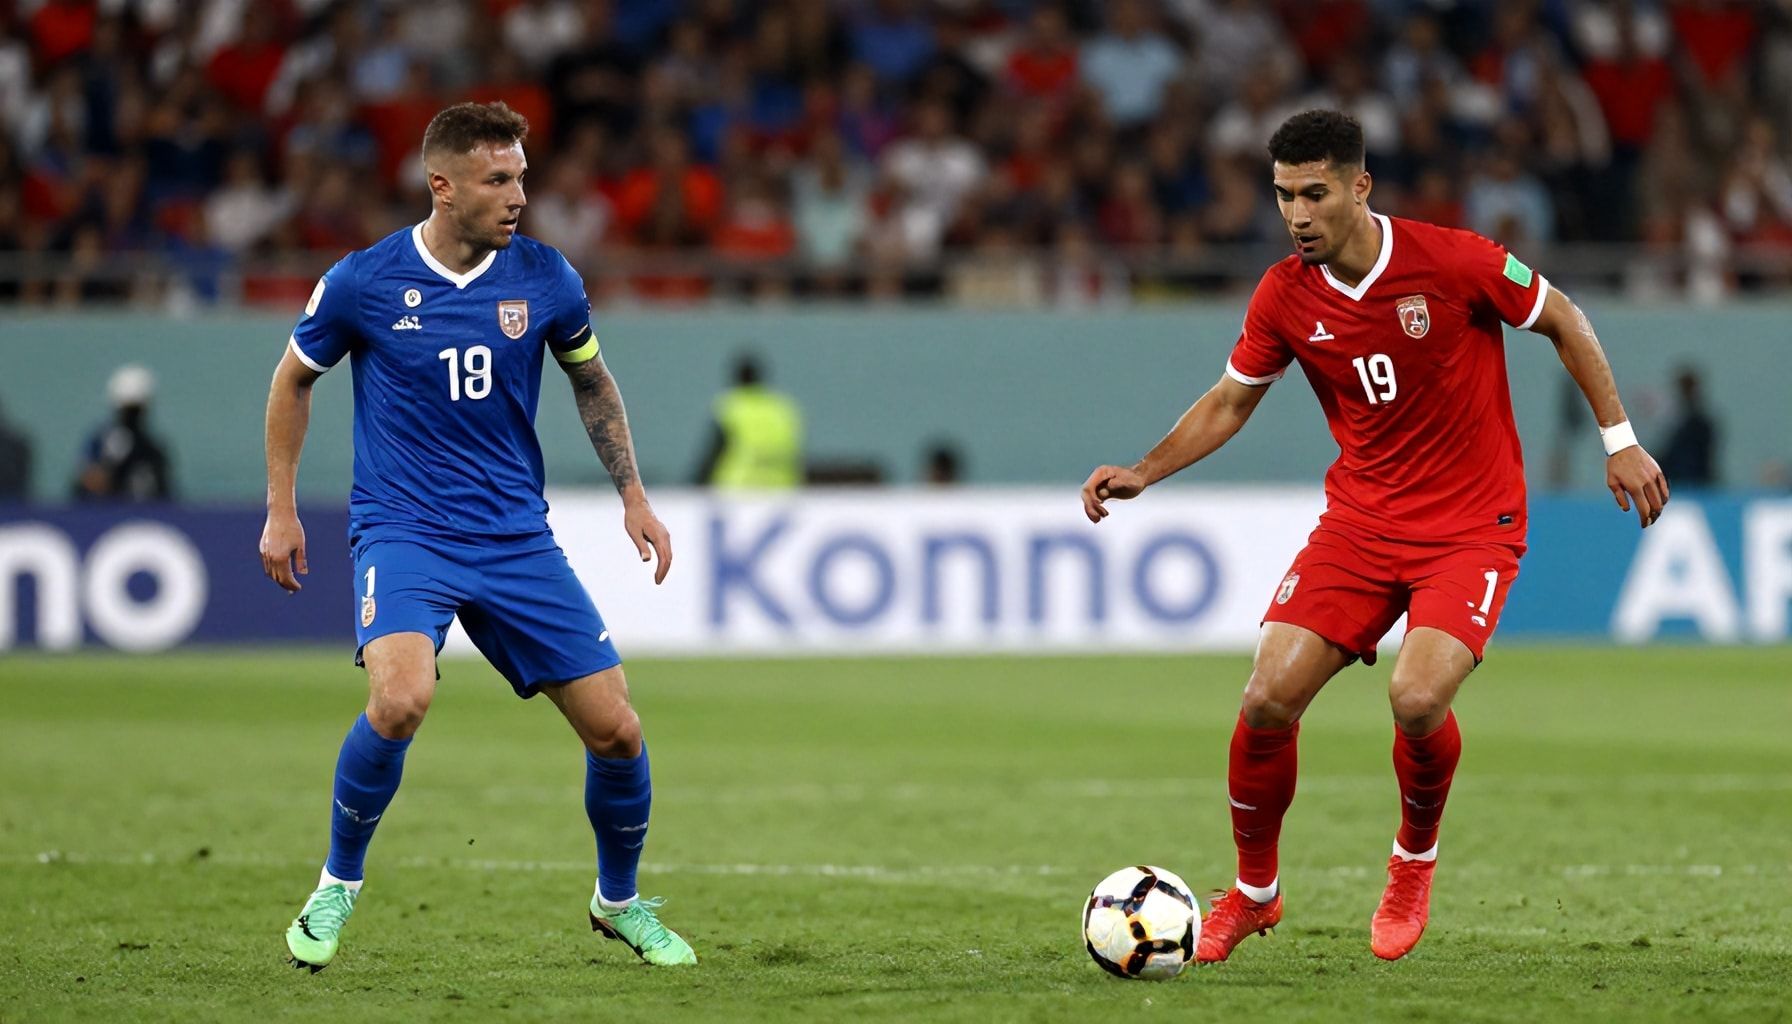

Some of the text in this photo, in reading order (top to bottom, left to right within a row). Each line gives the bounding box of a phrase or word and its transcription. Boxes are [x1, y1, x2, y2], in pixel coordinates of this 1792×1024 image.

[1352, 353, 1398, 404] 19
[364, 566, 376, 597] 1
[706, 512, 1225, 630] Konno
[1478, 568, 1499, 616] 1
